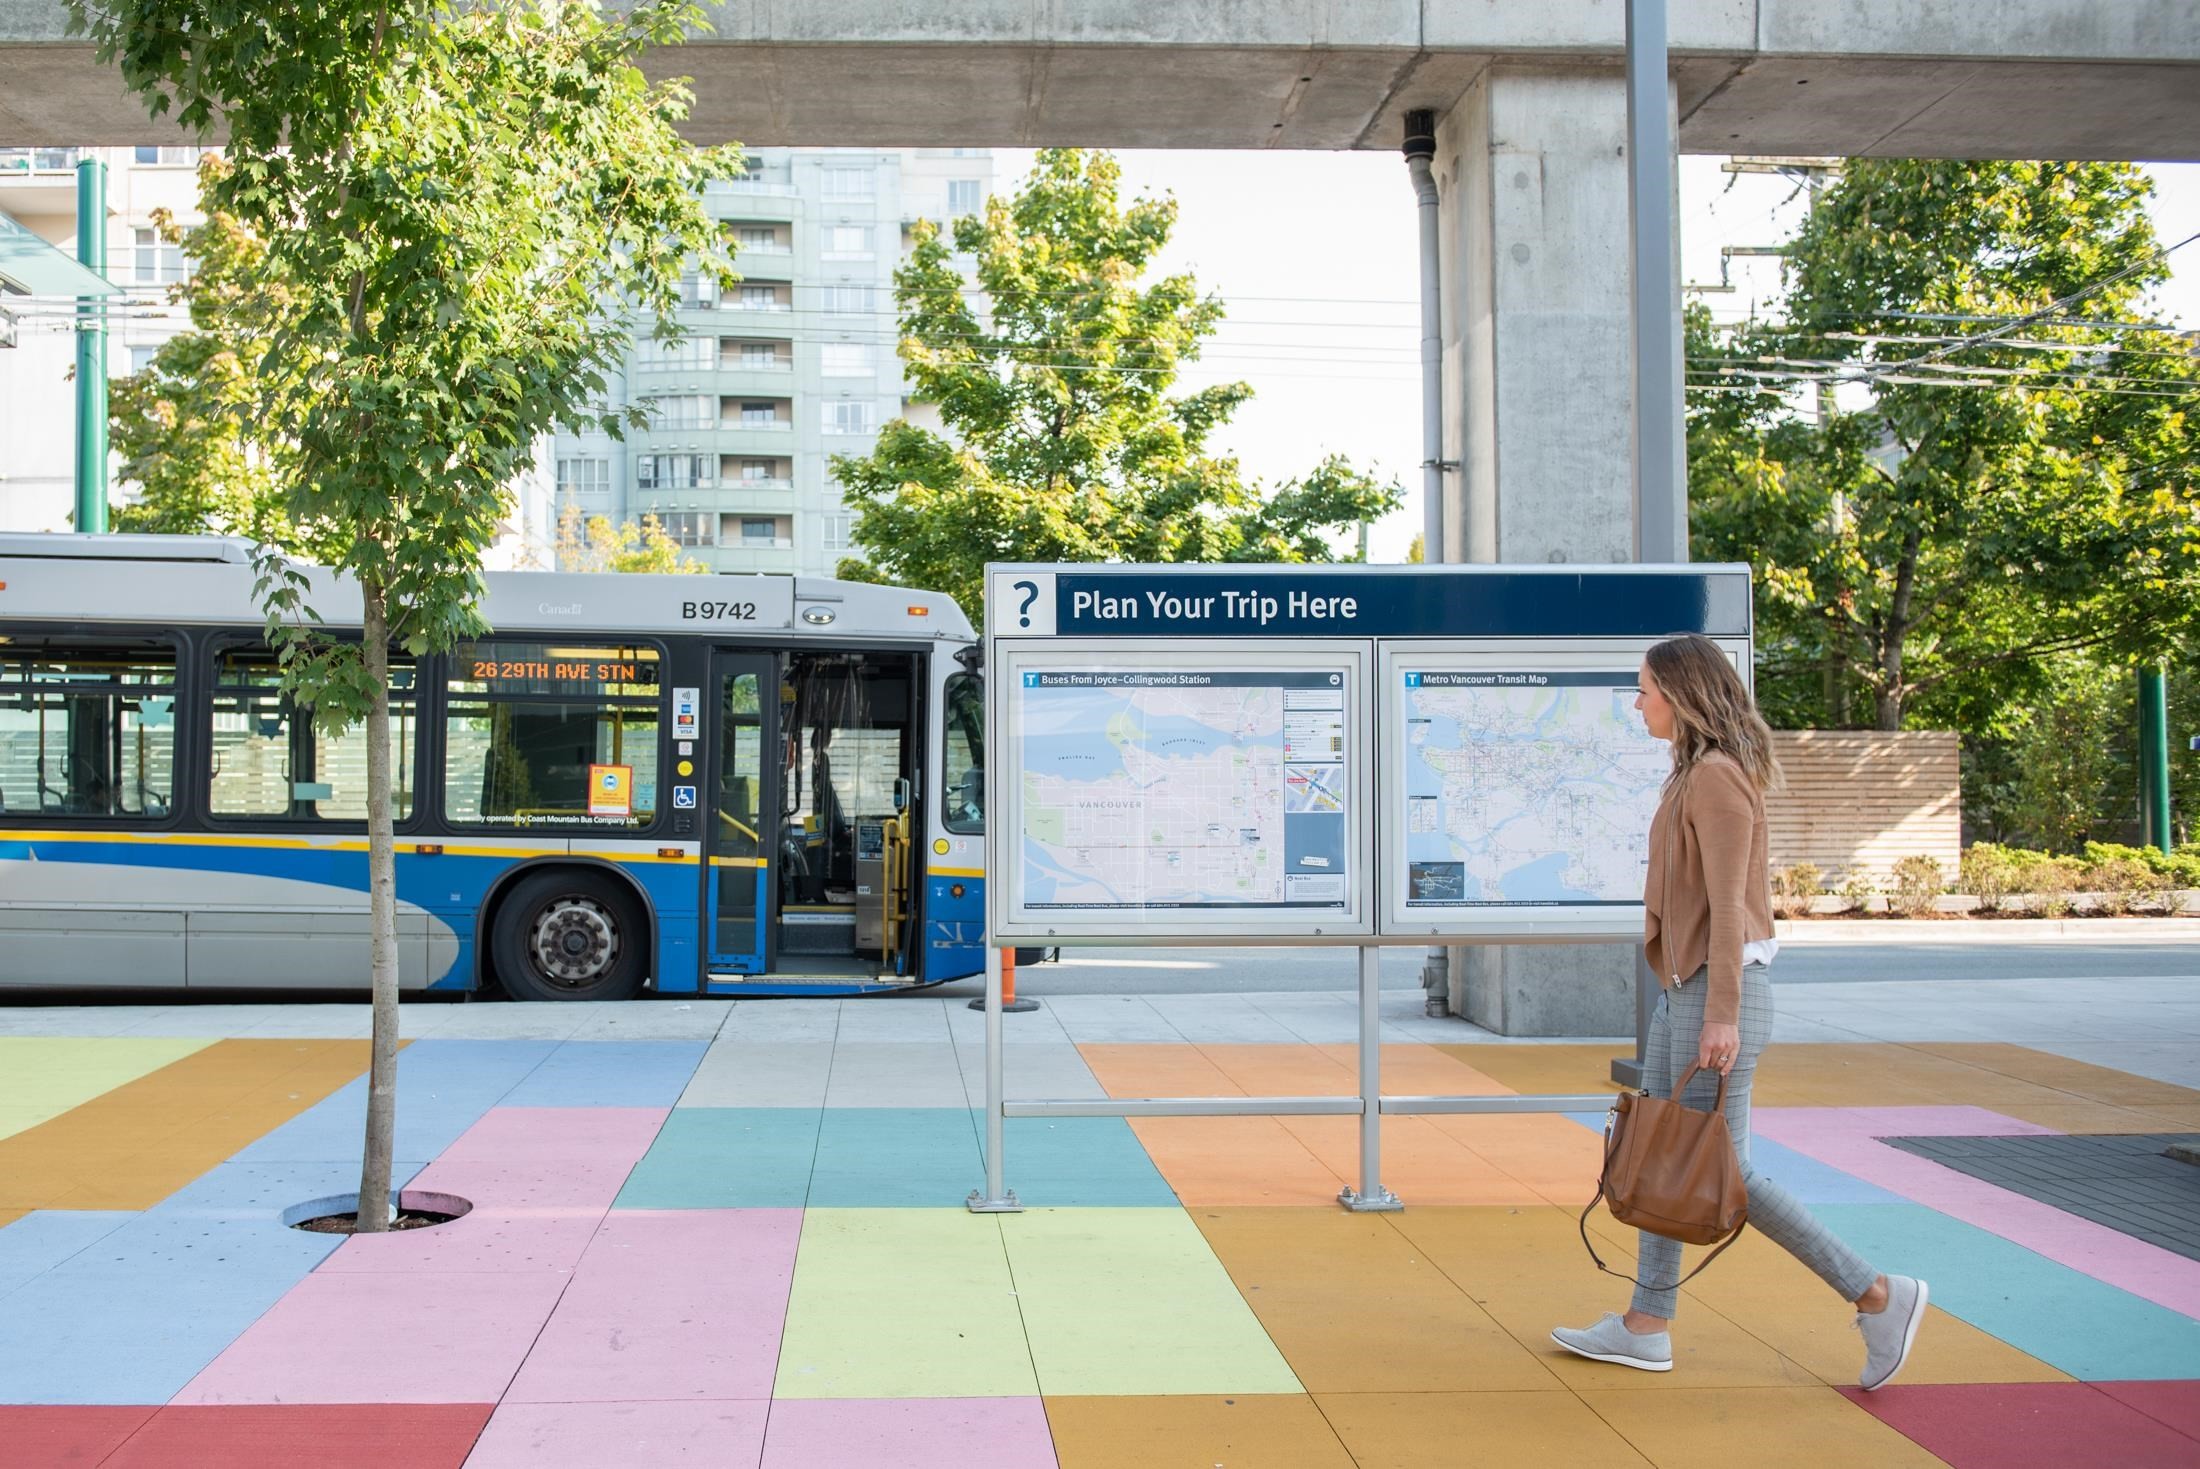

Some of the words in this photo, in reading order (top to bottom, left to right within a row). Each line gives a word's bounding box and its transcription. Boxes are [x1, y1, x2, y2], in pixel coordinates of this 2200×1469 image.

[538, 603, 582, 616] Canada
[1073, 590, 1138, 619] Plan
[1146, 591, 1214, 619] Your
[1221, 590, 1278, 626] Trip
[1289, 591, 1358, 619] Here
[474, 662, 498, 678] 26
[501, 662, 549, 679] 29TH
[555, 663, 591, 680] AVE
[597, 664, 635, 681] STN
[1041, 675, 1069, 684] Buses
[1071, 675, 1092, 684] From
[1179, 675, 1211, 684] Station
[1423, 675, 1449, 684] Metro
[1450, 674, 1495, 684] Vancouver
[1497, 674, 1527, 684] Transit
[1528, 674, 1548, 685] Map
[1079, 801, 1142, 809] VANCOUVER
[486, 815, 517, 823] operated
[518, 815, 527, 824] by
[527, 815, 546, 823] Coast
[547, 815, 580, 823] Mountain
[593, 816, 626, 825] Company
[626, 816, 639, 824] Ltd.
